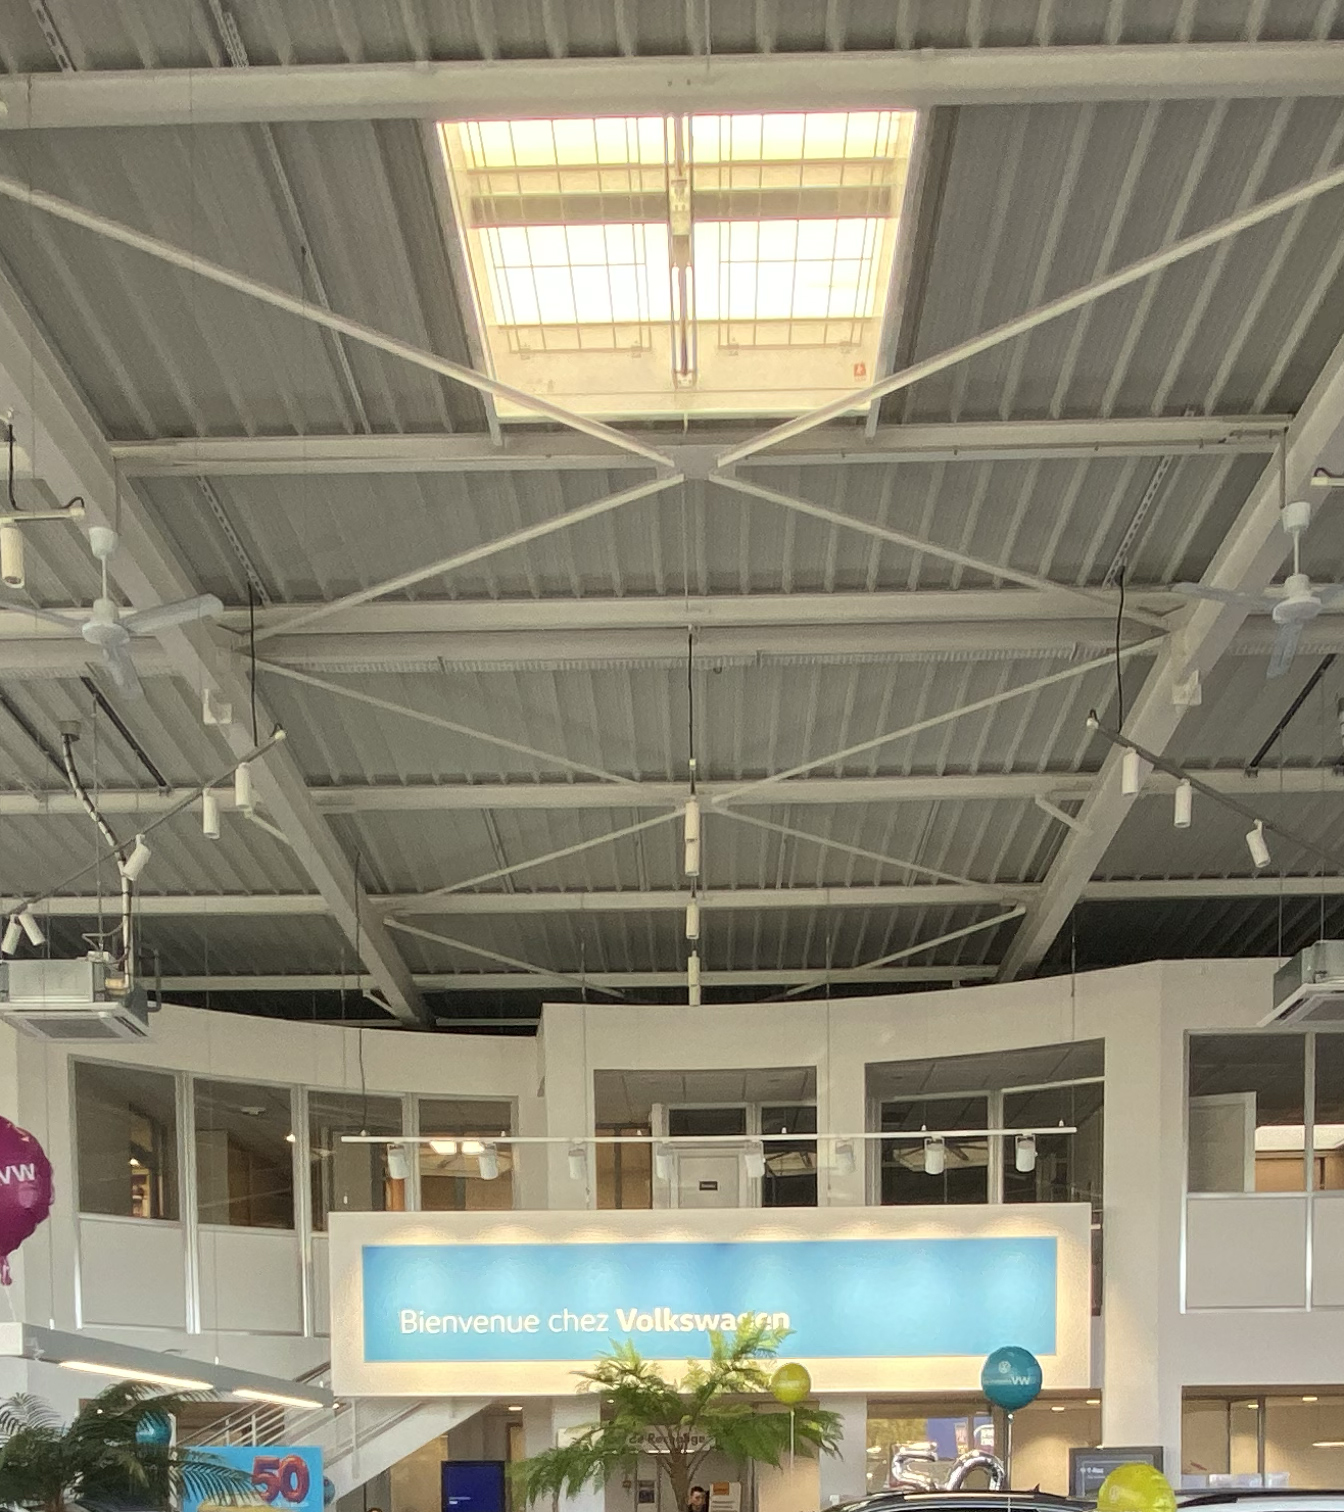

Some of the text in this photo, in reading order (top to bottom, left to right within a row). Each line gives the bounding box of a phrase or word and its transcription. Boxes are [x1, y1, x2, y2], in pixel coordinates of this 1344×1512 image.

[400, 1309, 540, 1334] Bienvenue
[548, 1308, 610, 1333] chez
[251, 1454, 311, 1503] 50
